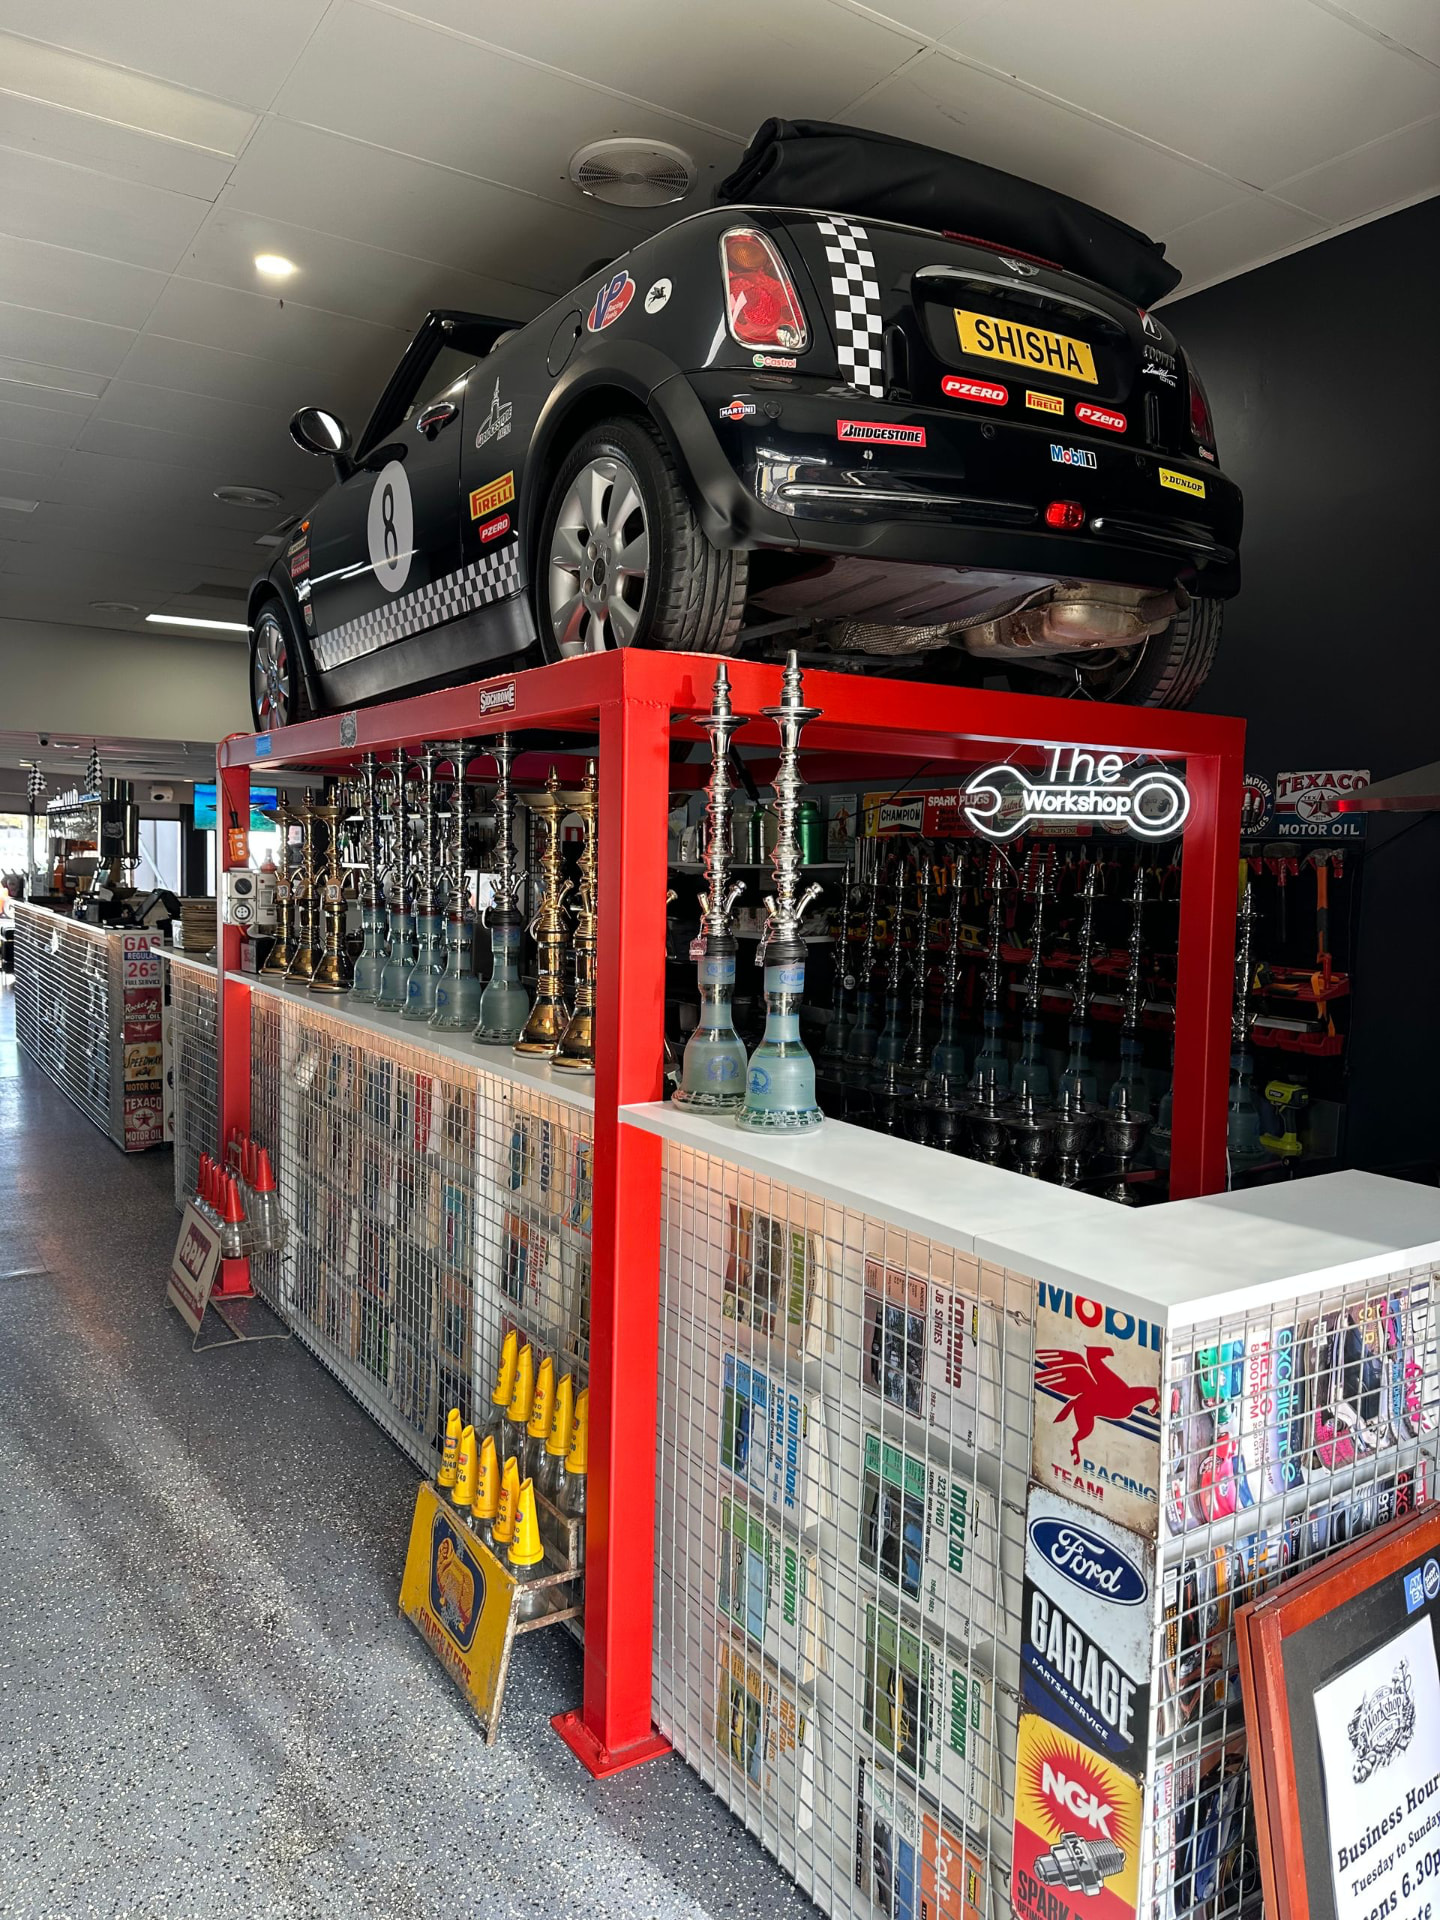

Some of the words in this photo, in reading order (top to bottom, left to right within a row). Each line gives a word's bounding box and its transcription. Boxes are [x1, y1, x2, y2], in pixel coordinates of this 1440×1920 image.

[975, 319, 1084, 375] SHISHA
[764, 357, 797, 368] Castrol
[946, 381, 1004, 401] PZERO
[1027, 393, 1062, 413] PIRELLI
[721, 406, 755, 417] MARTINI
[842, 424, 921, 442] BRIDGESTONE
[472, 475, 513, 517] PIRELLI
[1169, 475, 1203, 492] DUNLOP
[382, 483, 398, 570] 8
[482, 519, 508, 540] PZERO
[1044, 745, 1123, 783] The
[1277, 772, 1368, 799] TEXACO
[928, 796, 956, 807] SPARK
[959, 793, 990, 805] PLUGS
[1023, 790, 1132, 817] Workshop
[881, 808, 920, 822] CHAMPION
[1279, 824, 1327, 835] MOTOR
[1331, 824, 1359, 835] OIL
[124, 936, 161, 951] GAS
[126, 1083, 149, 1091] MOTOR
[125, 1097, 162, 1112] TEXACO
[126, 1132, 149, 1140] MOTOR
[150, 1130, 162, 1138] OIL
[934, 1289, 944, 1304] JB
[1038, 1281, 1160, 1352] Mobil
[1260, 1341, 1273, 1416] HELLO
[1249, 1383, 1260, 1419] RPM
[1277, 1330, 1299, 1483] excellence
[937, 1475, 947, 1497] 323
[1051, 1463, 1104, 1503] TEAM
[1083, 1459, 1157, 1504] RACING
[935, 1500, 945, 1527] FWD
[1378, 1493, 1389, 1524] 918
[949, 1483, 968, 1574] MAZDA
[1051, 1528, 1123, 1594] Ford
[1030, 1590, 1137, 1744] GARAGE
[1360, 1697, 1401, 1733] Workshop
[1042, 1761, 1114, 1839] NGK
[1337, 1806, 1402, 1873] Business
[1351, 1852, 1394, 1897] Tuesday
[1397, 1843, 1406, 1859] to
[1408, 1809, 1440, 1847] Sunday
[1070, 1840, 1088, 1867] NGK
[934, 1837, 953, 1902] Colt
